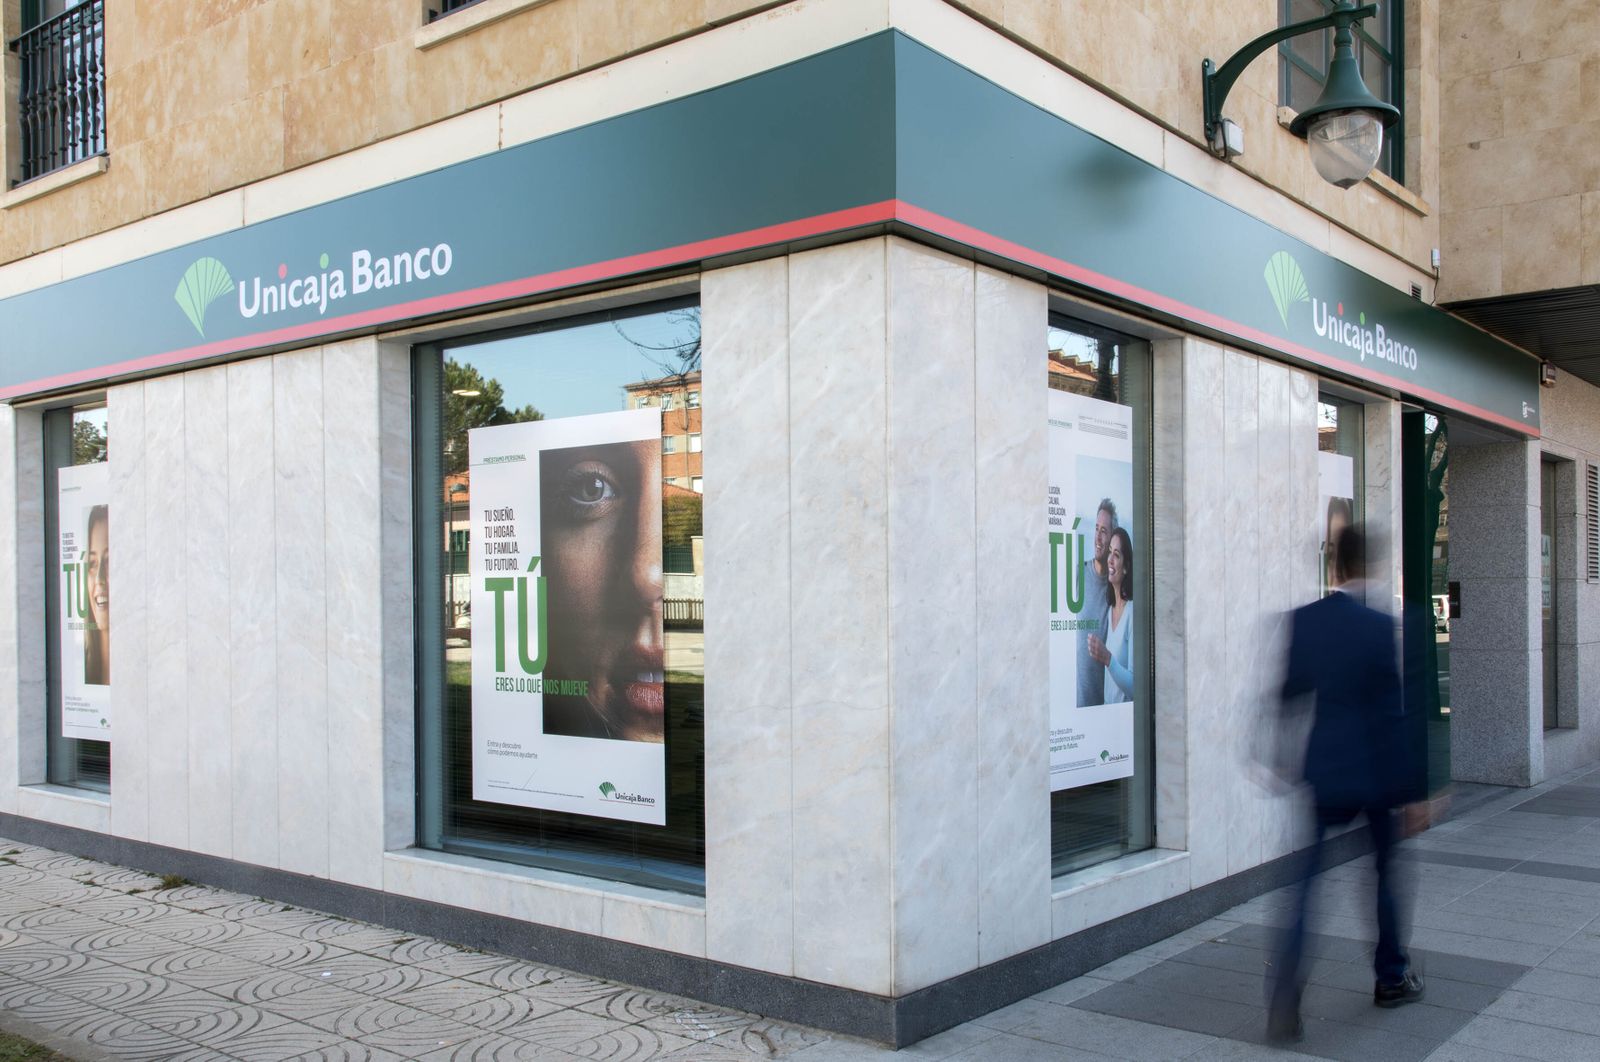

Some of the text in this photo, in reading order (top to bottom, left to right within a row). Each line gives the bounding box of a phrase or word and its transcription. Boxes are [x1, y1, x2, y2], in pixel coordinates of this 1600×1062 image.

[239, 243, 452, 318] Unicaja Banco
[1313, 298, 1418, 371] Unicaja Banco
[484, 506, 515, 522] TU SUEÑO.
[484, 525, 516, 538] TU HOGAR.
[485, 541, 520, 555] TU FAMILIA.
[485, 558, 519, 571] TU FUTURO.
[1049, 517, 1084, 613] TÚ
[63, 551, 88, 618] TÚ
[485, 556, 548, 675] TÚ
[1051, 620, 1061, 631] ERES
[495, 677, 589, 696] ERES LO QUE NOS MUEVE
[615, 792, 655, 803] Unicaja Banco
